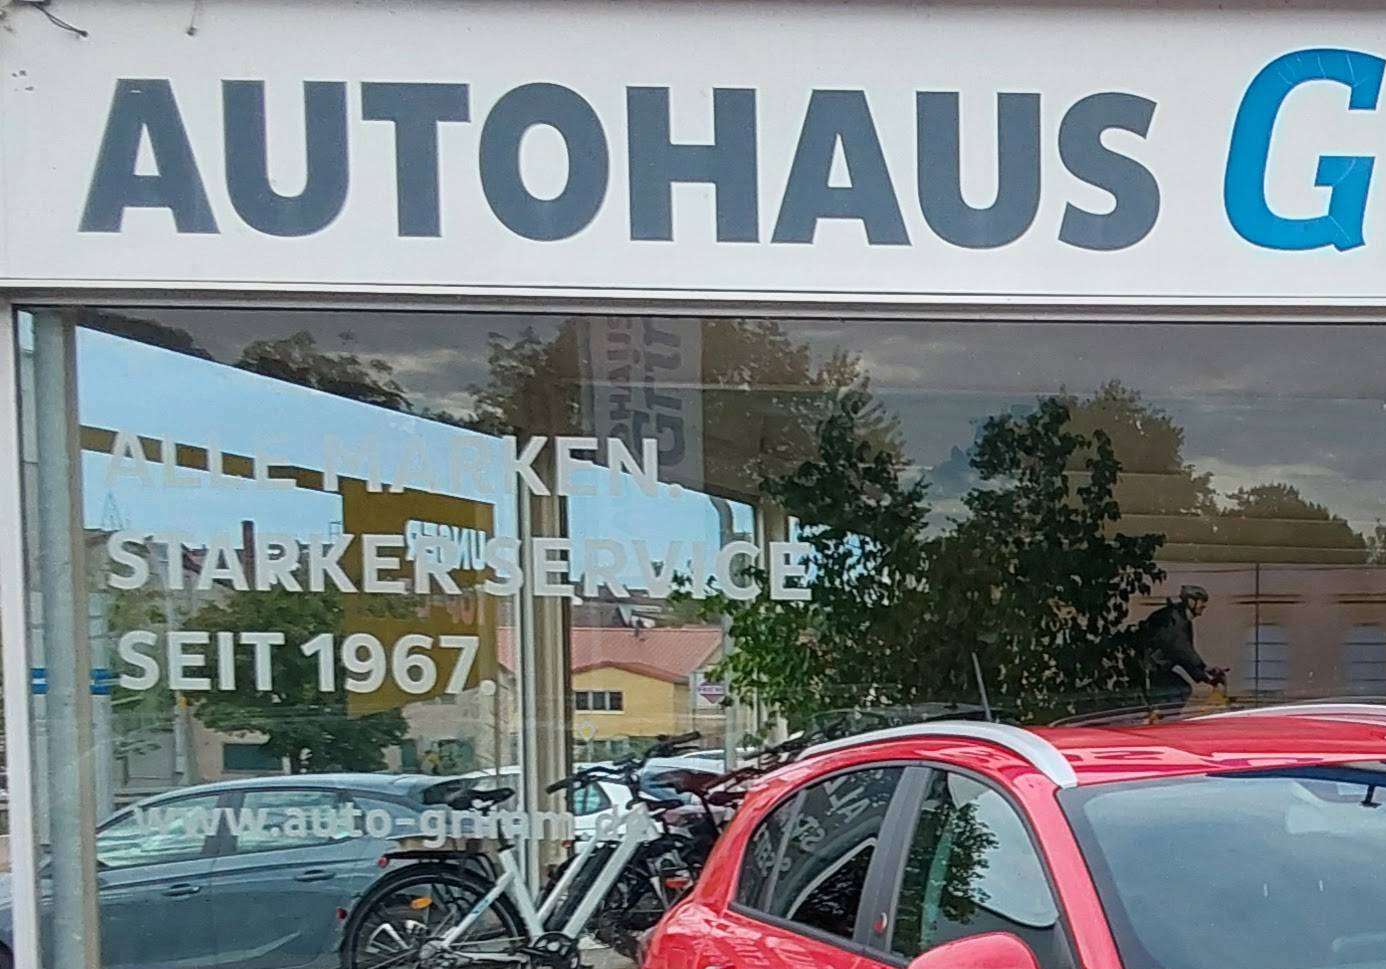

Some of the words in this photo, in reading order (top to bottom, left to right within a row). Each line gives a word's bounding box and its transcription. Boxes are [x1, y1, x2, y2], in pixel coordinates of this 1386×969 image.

[78, 78, 1160, 251] AUTOHAUS
[106, 429, 297, 488] ALLE
[323, 433, 682, 498] MARKEN.
[107, 530, 463, 595] STARKER
[484, 536, 813, 602] SERVICE
[118, 631, 286, 692] SEIT
[300, 633, 497, 696] 1967.
